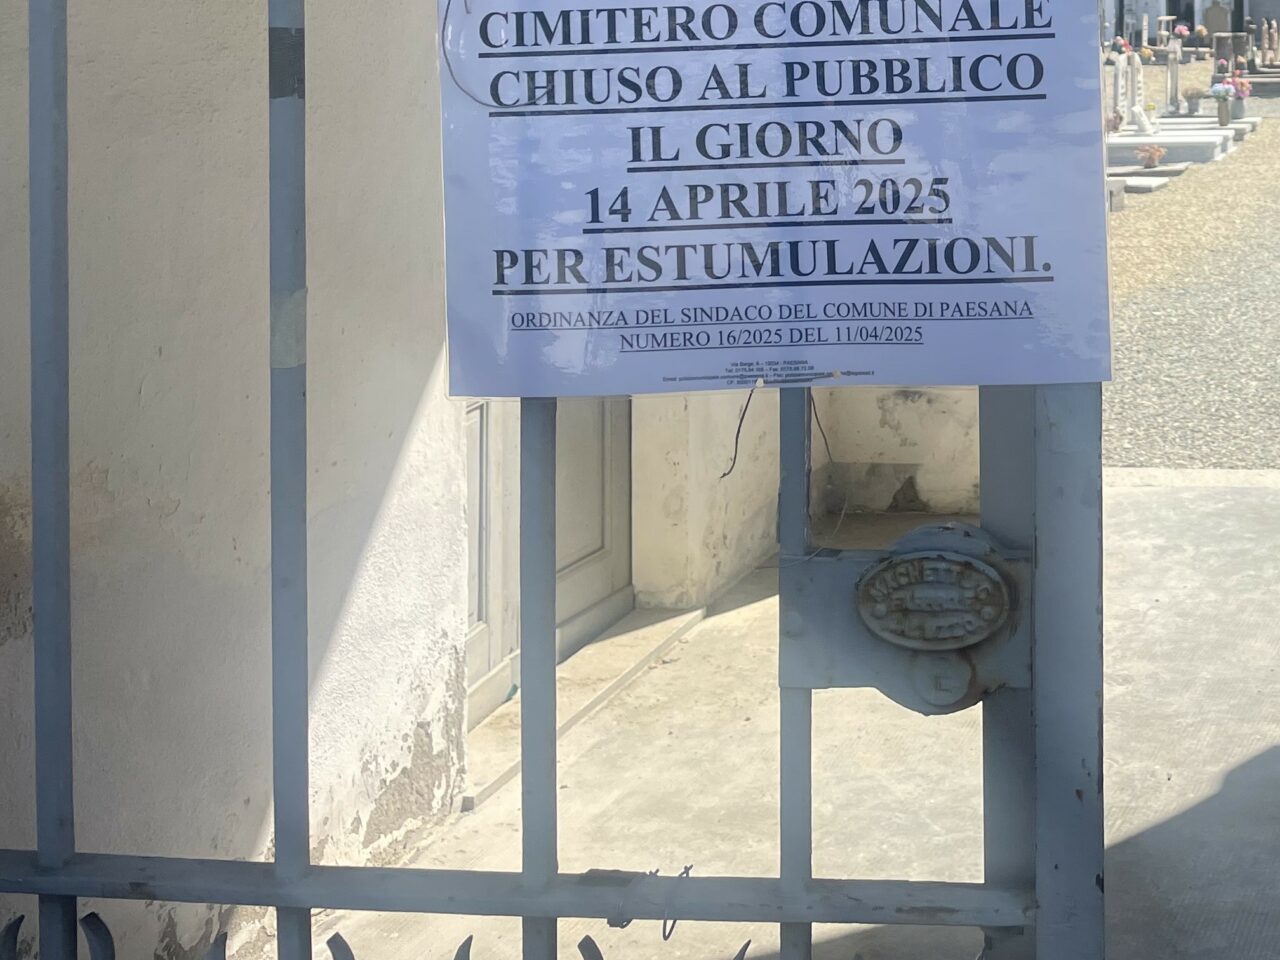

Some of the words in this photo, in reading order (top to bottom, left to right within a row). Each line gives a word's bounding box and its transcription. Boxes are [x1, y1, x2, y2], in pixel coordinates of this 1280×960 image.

[479, 3, 738, 50] CIMITERO
[488, 64, 683, 109] CHIUSO
[697, 61, 767, 102] AL
[784, 53, 1046, 100] PUBBLICO
[627, 123, 681, 164] IL
[695, 117, 904, 161] GIORNO
[585, 186, 633, 226] 14
[647, 179, 838, 224] APRILE
[852, 176, 951, 216] 2025
[493, 248, 590, 287] PER
[604, 234, 1053, 284] ESTUMULAZIONI.
[511, 310, 631, 329] ORDINANZA
[634, 308, 679, 324] DEL
[681, 305, 773, 324] SINDACO
[777, 304, 820, 320] DEL
[822, 302, 911, 320] COMUNE
[915, 301, 937, 318] DI
[939, 298, 1033, 318] PAESANA
[620, 330, 713, 348] NUMERO
[716, 328, 784, 346] 16/2025
[788, 327, 831, 344] DEL
[834, 325, 924, 344] 11/04/2025
